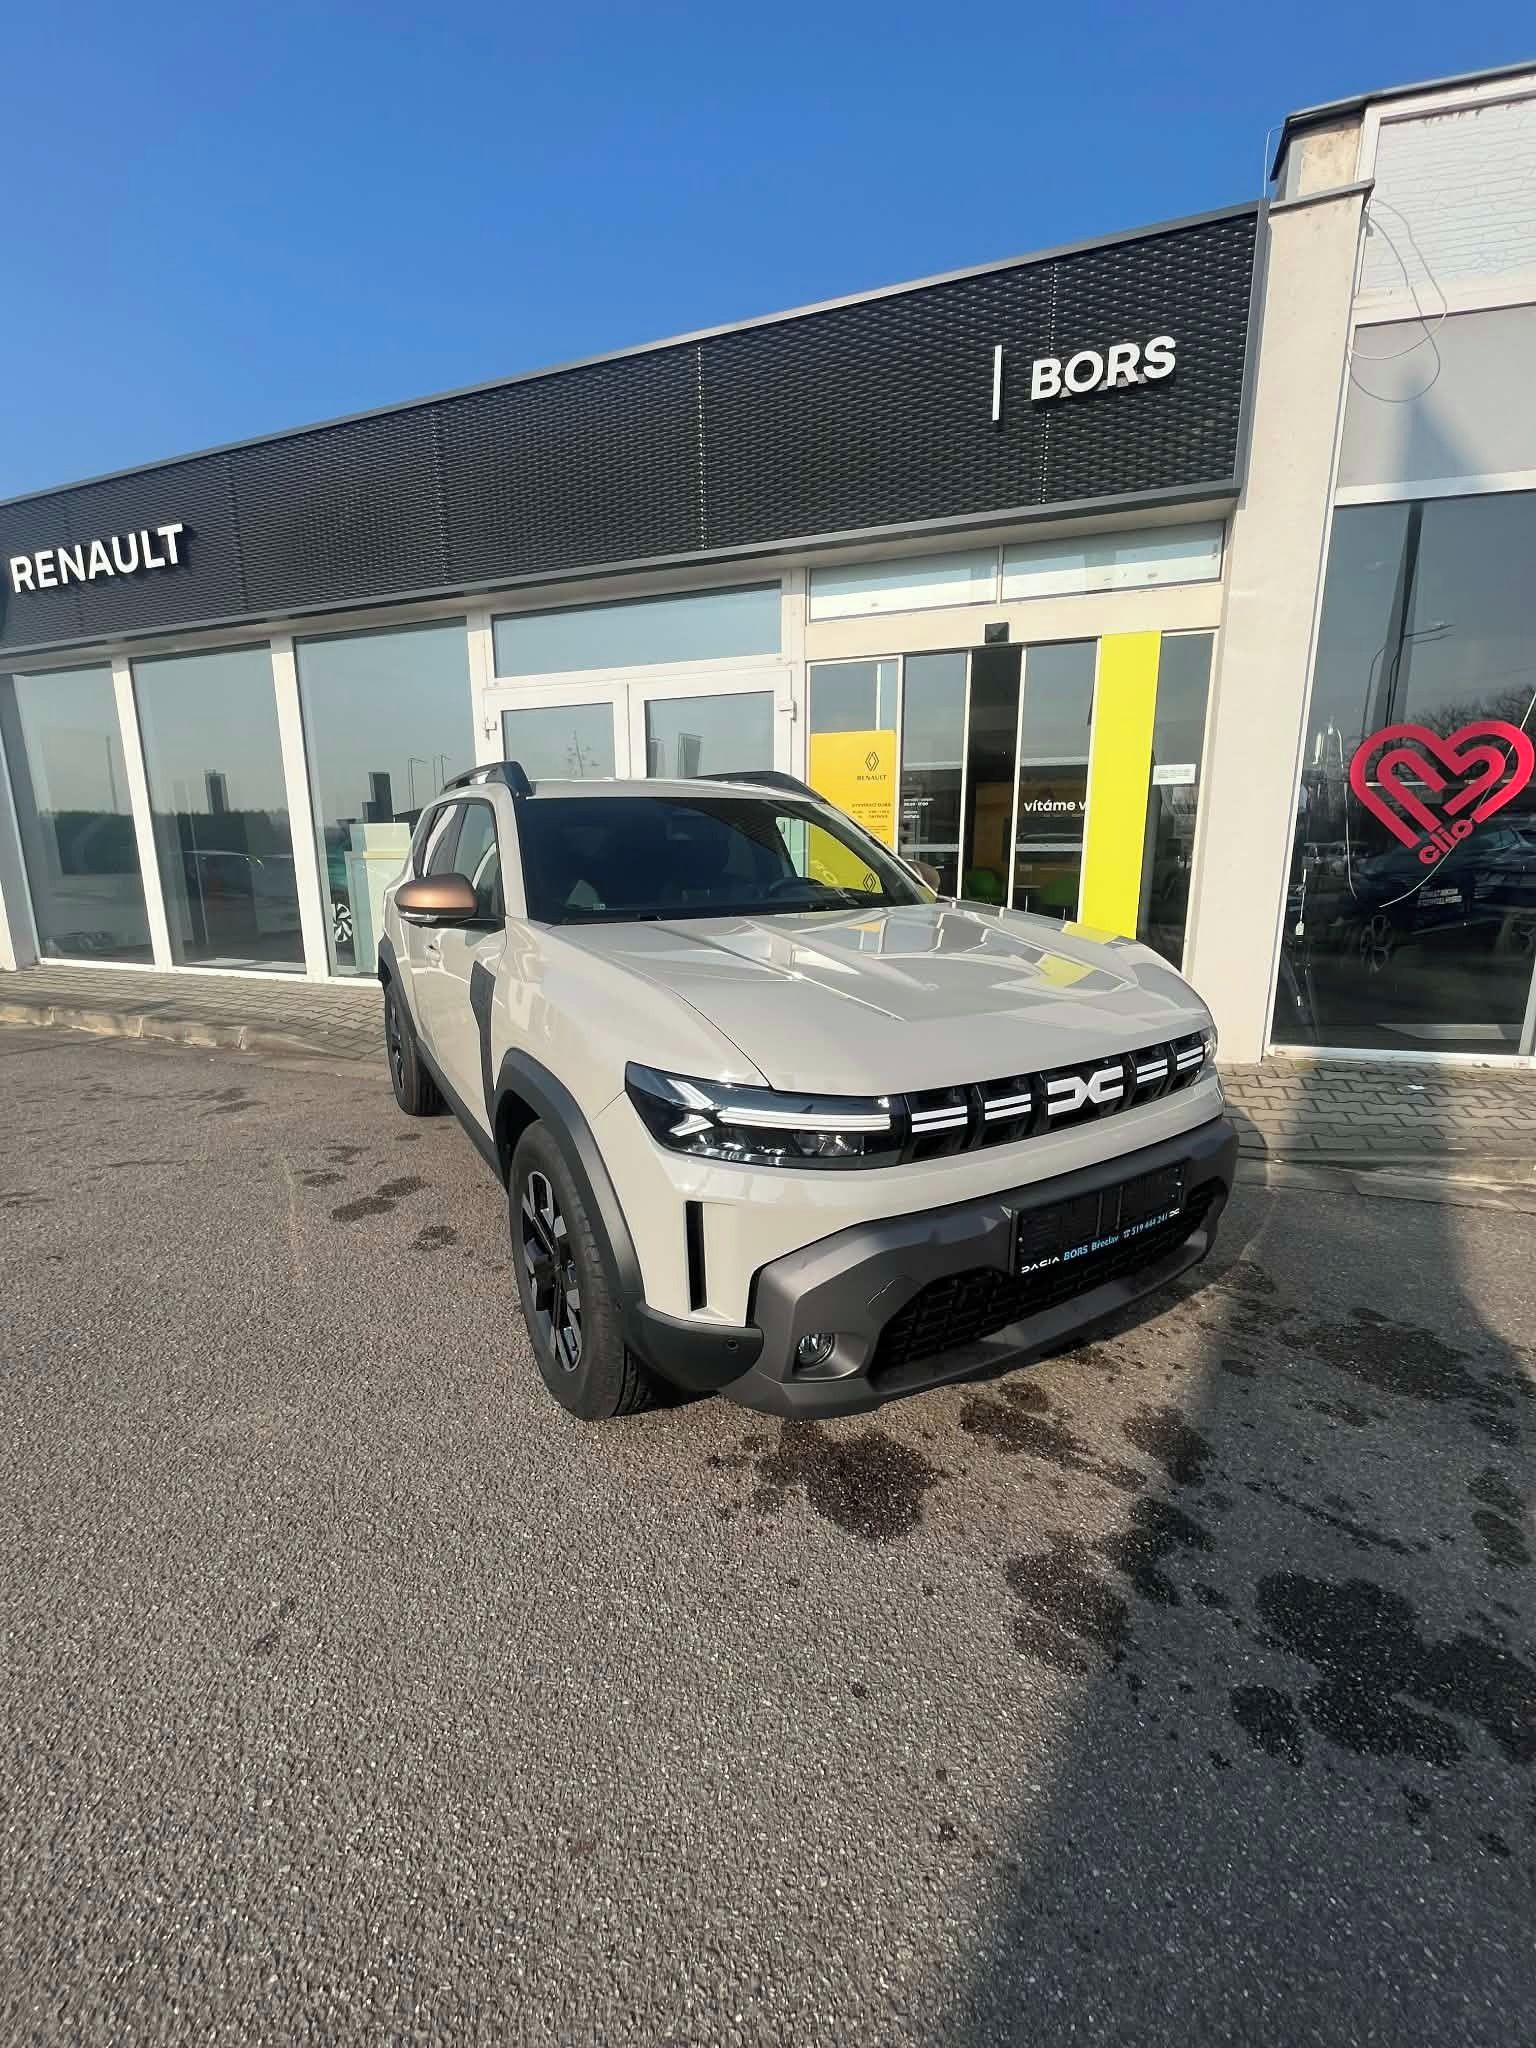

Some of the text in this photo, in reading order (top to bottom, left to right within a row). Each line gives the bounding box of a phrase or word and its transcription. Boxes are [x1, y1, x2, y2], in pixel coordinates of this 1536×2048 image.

[1031, 336, 1176, 400] BORS
[10, 523, 183, 593] RENAULT
[1024, 799, 1076, 812] vítáme
[1419, 819, 1473, 864] clio
[1021, 1256, 1060, 1274] DACIA
[1063, 1244, 1089, 1261] BORS
